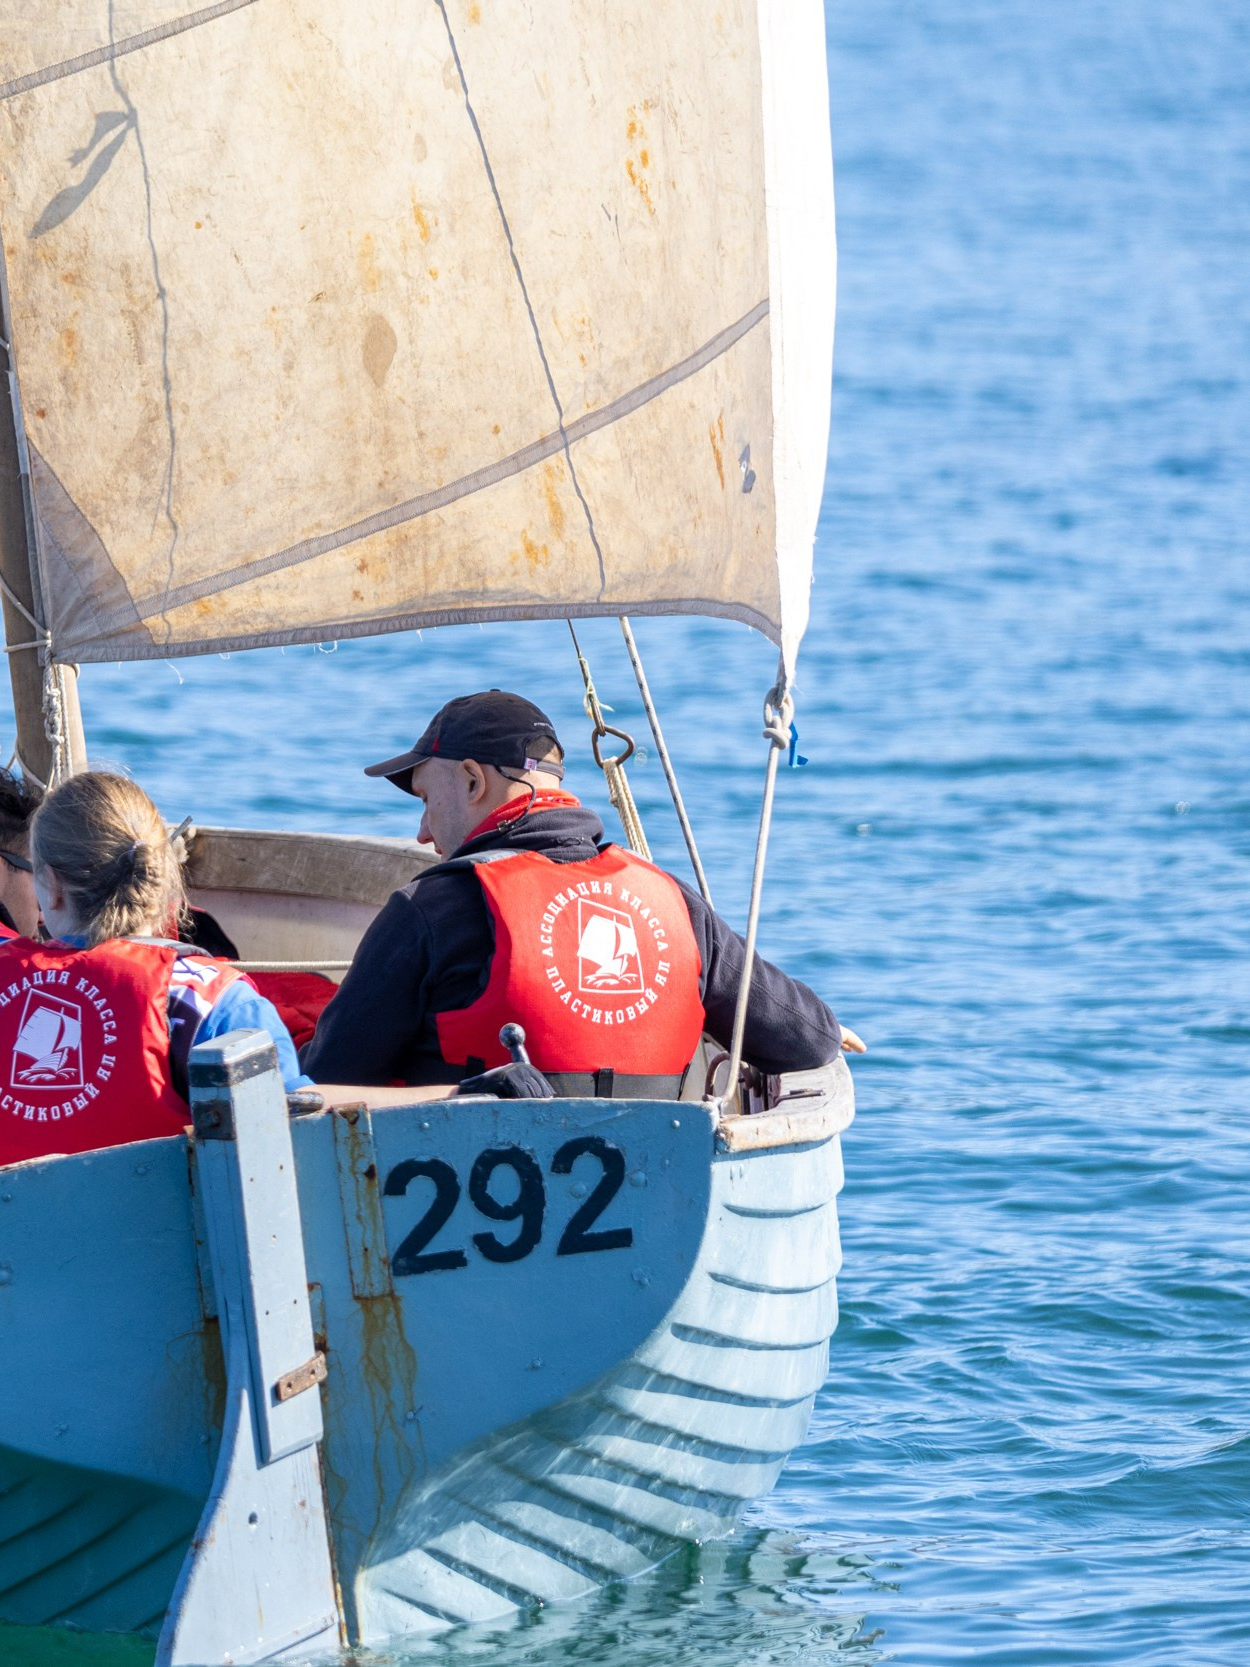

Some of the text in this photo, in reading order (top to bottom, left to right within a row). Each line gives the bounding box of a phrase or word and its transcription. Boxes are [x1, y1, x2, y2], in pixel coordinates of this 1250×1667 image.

[540, 881, 669, 957] АССОЦИАЦИЯ КЛАССА
[75, 977, 117, 1045] КЛАССА
[546, 960, 671, 1025] ПЛАСТИКОВЫЙ ЯЛ
[96, 1054, 116, 1081] ЯЛ
[383, 1136, 633, 1276] 292
